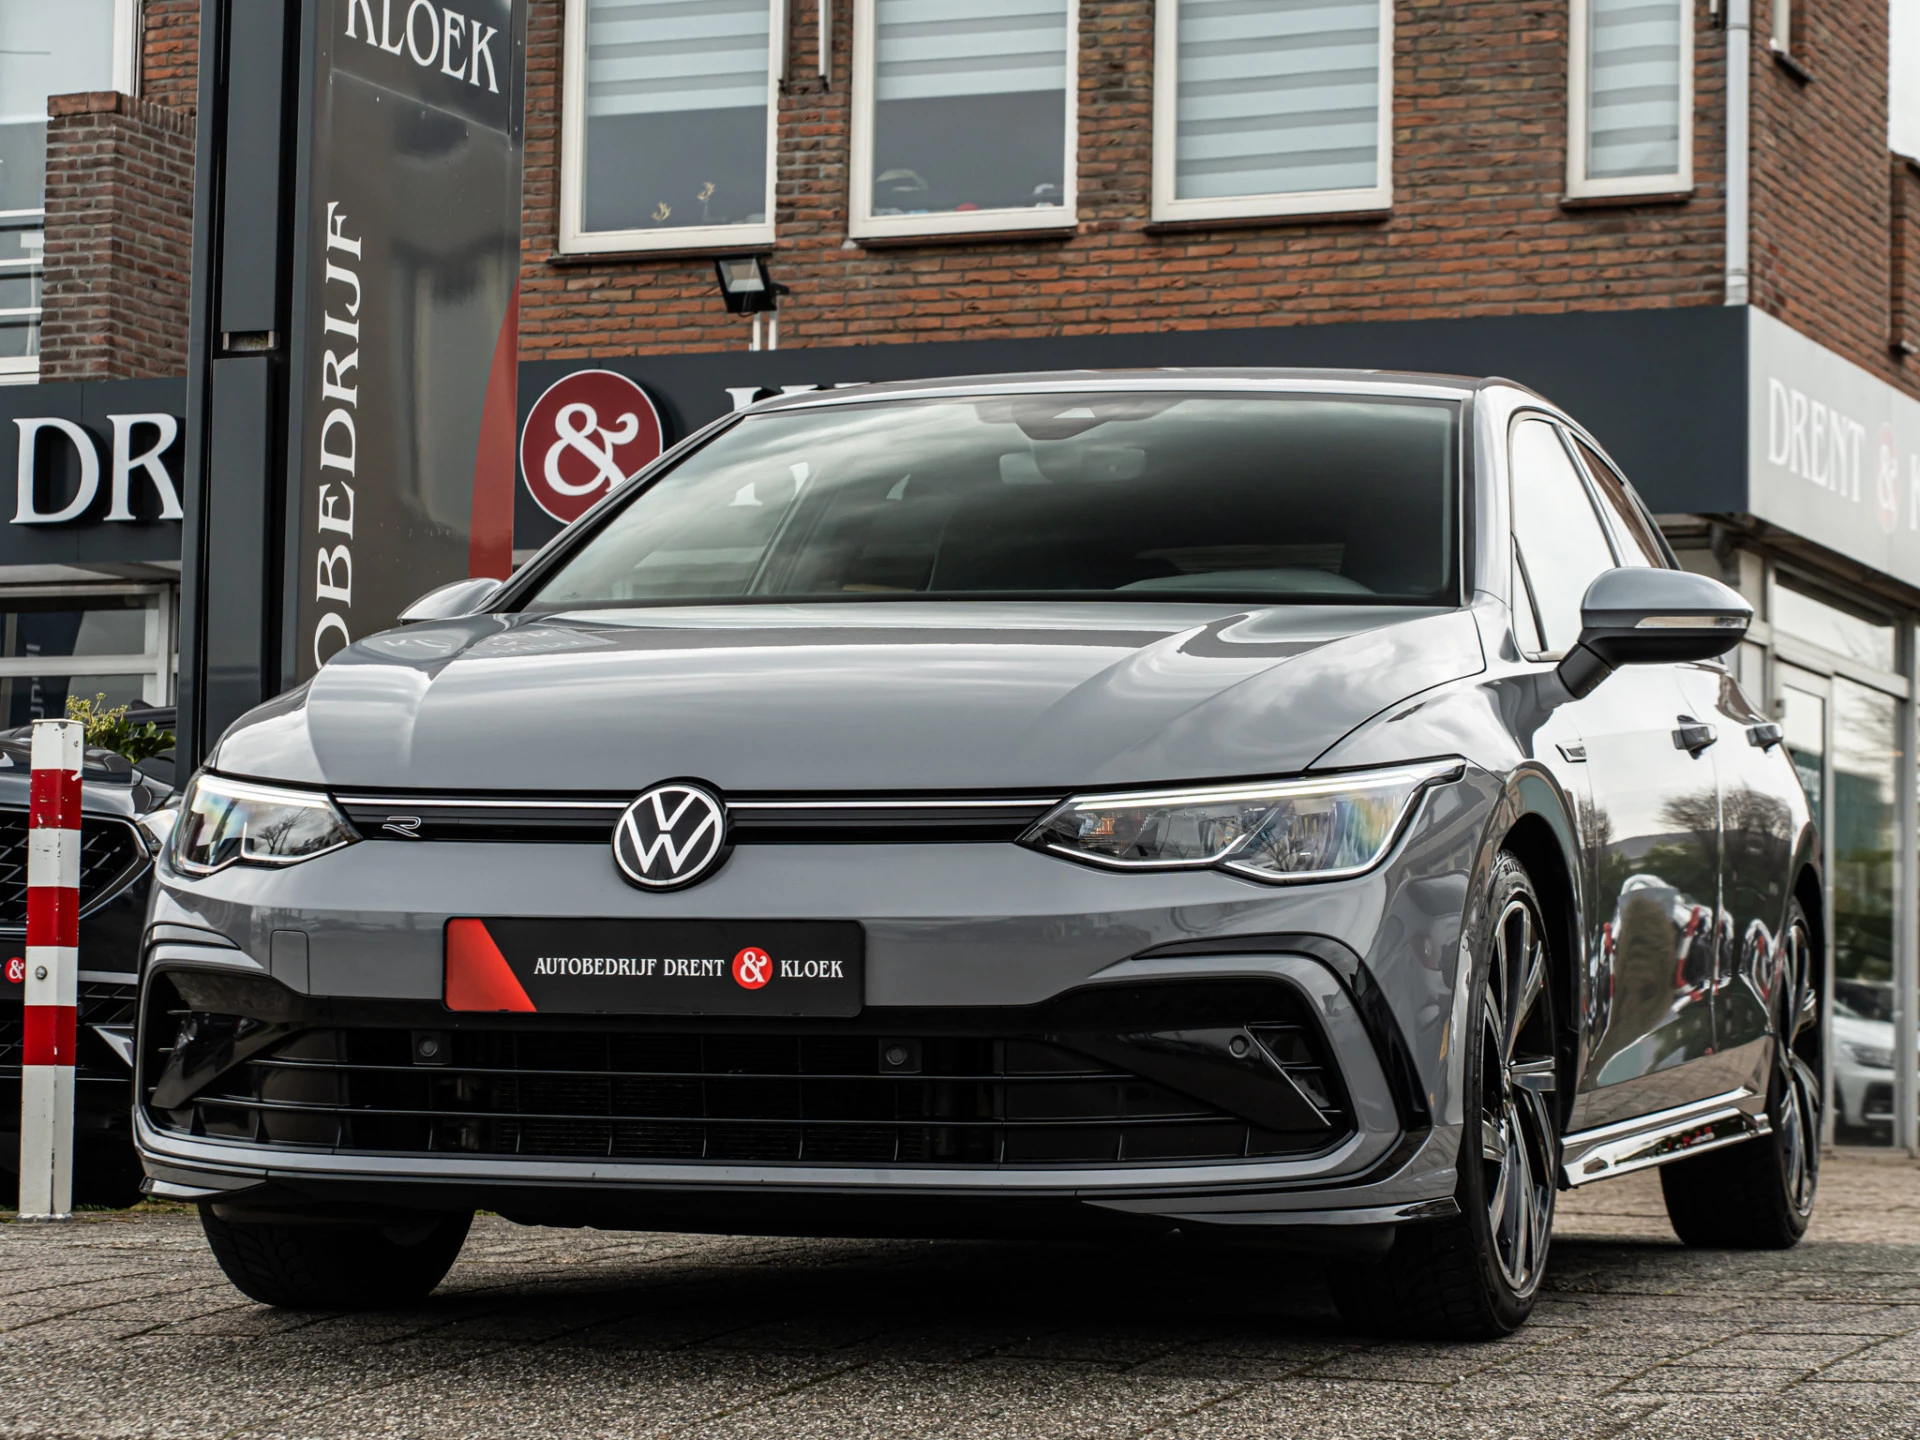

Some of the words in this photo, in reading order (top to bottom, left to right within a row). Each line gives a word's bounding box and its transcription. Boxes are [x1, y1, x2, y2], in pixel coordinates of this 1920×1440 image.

[345, 0, 499, 94] KLOEK
[9, 412, 184, 524] DR
[543, 402, 639, 496] &
[1768, 376, 1866, 502] DRENT
[1877, 444, 1898, 512] &
[533, 957, 657, 976] AUTOBEDRIJF
[663, 958, 725, 977] DRENT
[740, 951, 767, 983] &
[780, 959, 844, 978] KLOEK
